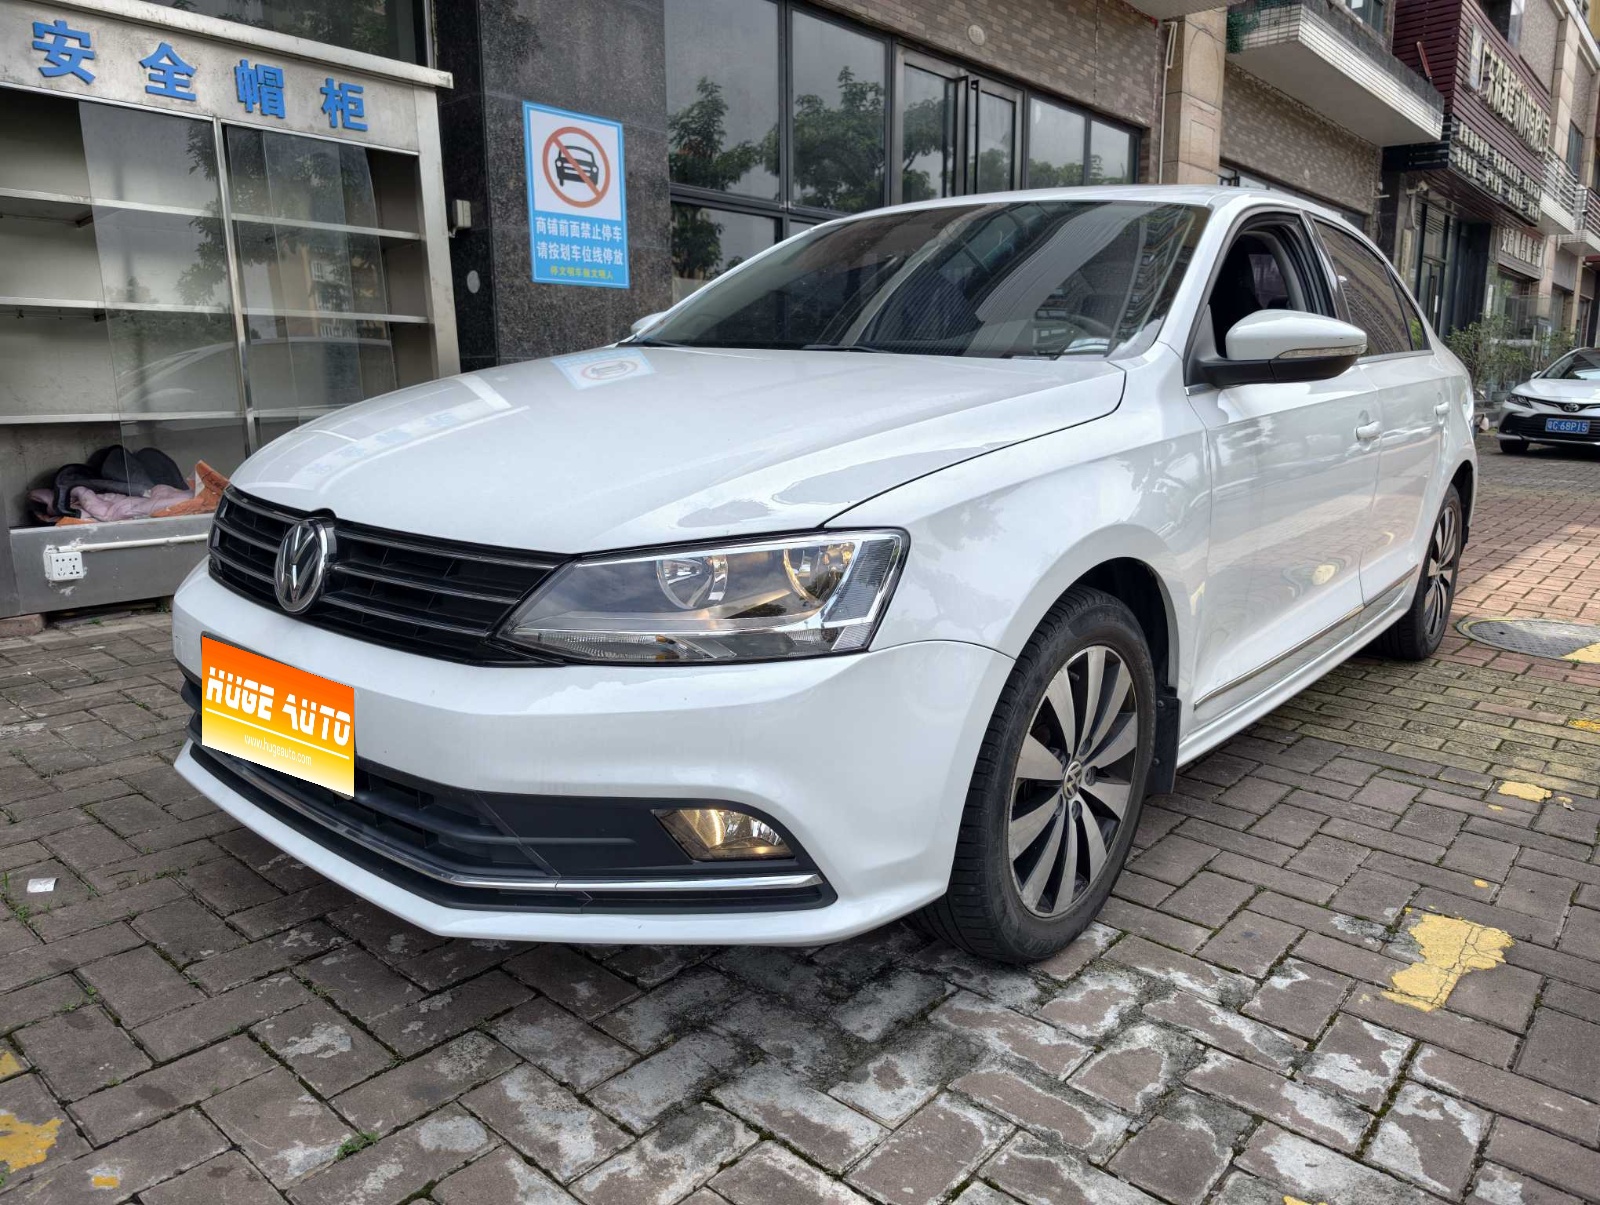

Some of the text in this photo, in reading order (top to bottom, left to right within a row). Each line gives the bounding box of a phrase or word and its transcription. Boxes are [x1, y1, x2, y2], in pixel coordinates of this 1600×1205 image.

[32, 20, 369, 132] 安全帽柜
[535, 216, 623, 243] 商铺前面禁止停车
[536, 241, 624, 266] 请按划车位线停放
